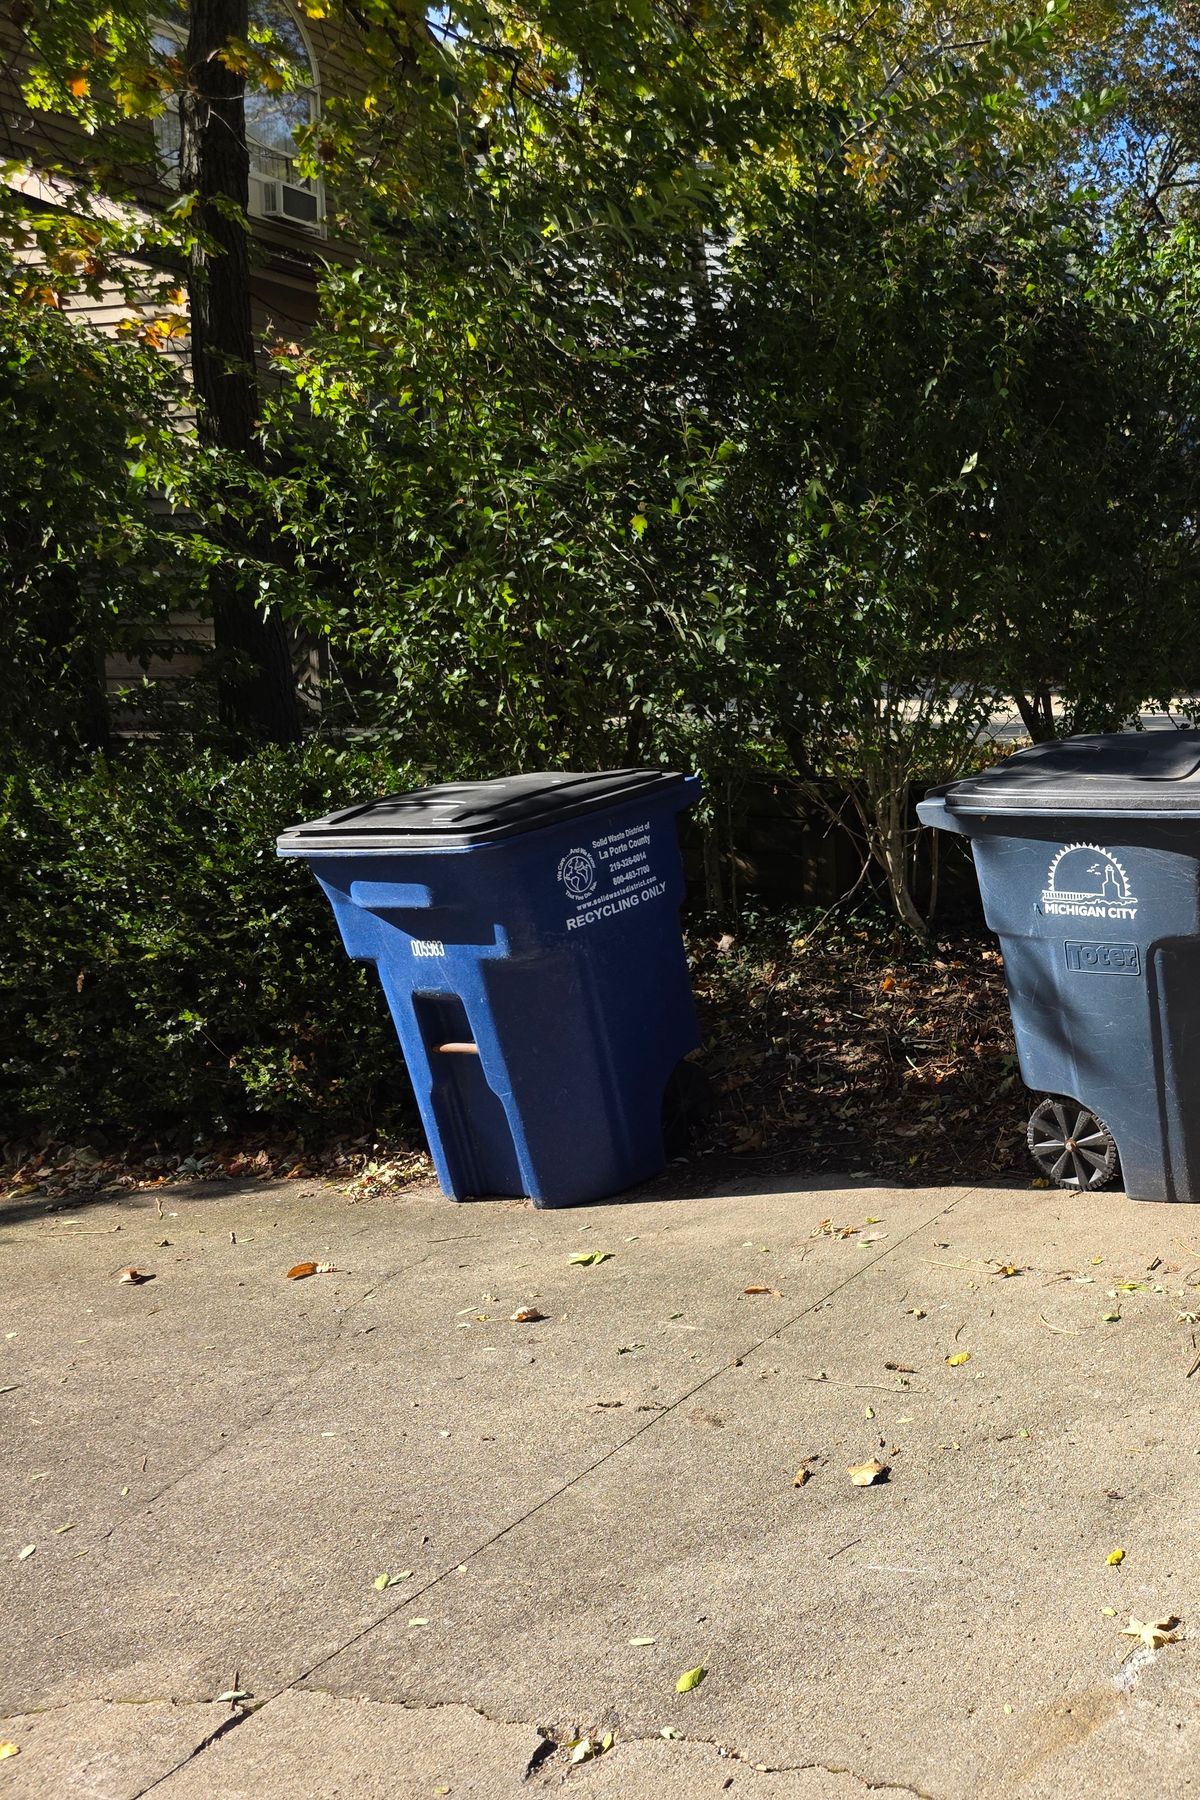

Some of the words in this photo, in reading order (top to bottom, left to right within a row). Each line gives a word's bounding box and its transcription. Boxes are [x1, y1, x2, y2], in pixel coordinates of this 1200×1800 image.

[592, 837, 608, 849] Solid
[608, 832, 625, 844] Waste
[625, 825, 644, 837] District
[644, 821, 650, 830] of
[598, 850, 609, 860] La
[609, 843, 628, 857] Porte
[628, 835, 651, 849] County
[609, 851, 647, 873] 219-326-0014
[612, 864, 650, 886] 800-483-7700
[576, 875, 657, 911] www.solidwastedistrict.com
[566, 894, 639, 931] RECYCLING
[641, 881, 666, 901] ONLY
[1044, 903, 1106, 919] MICHIGAN
[1107, 906, 1137, 920] CITY
